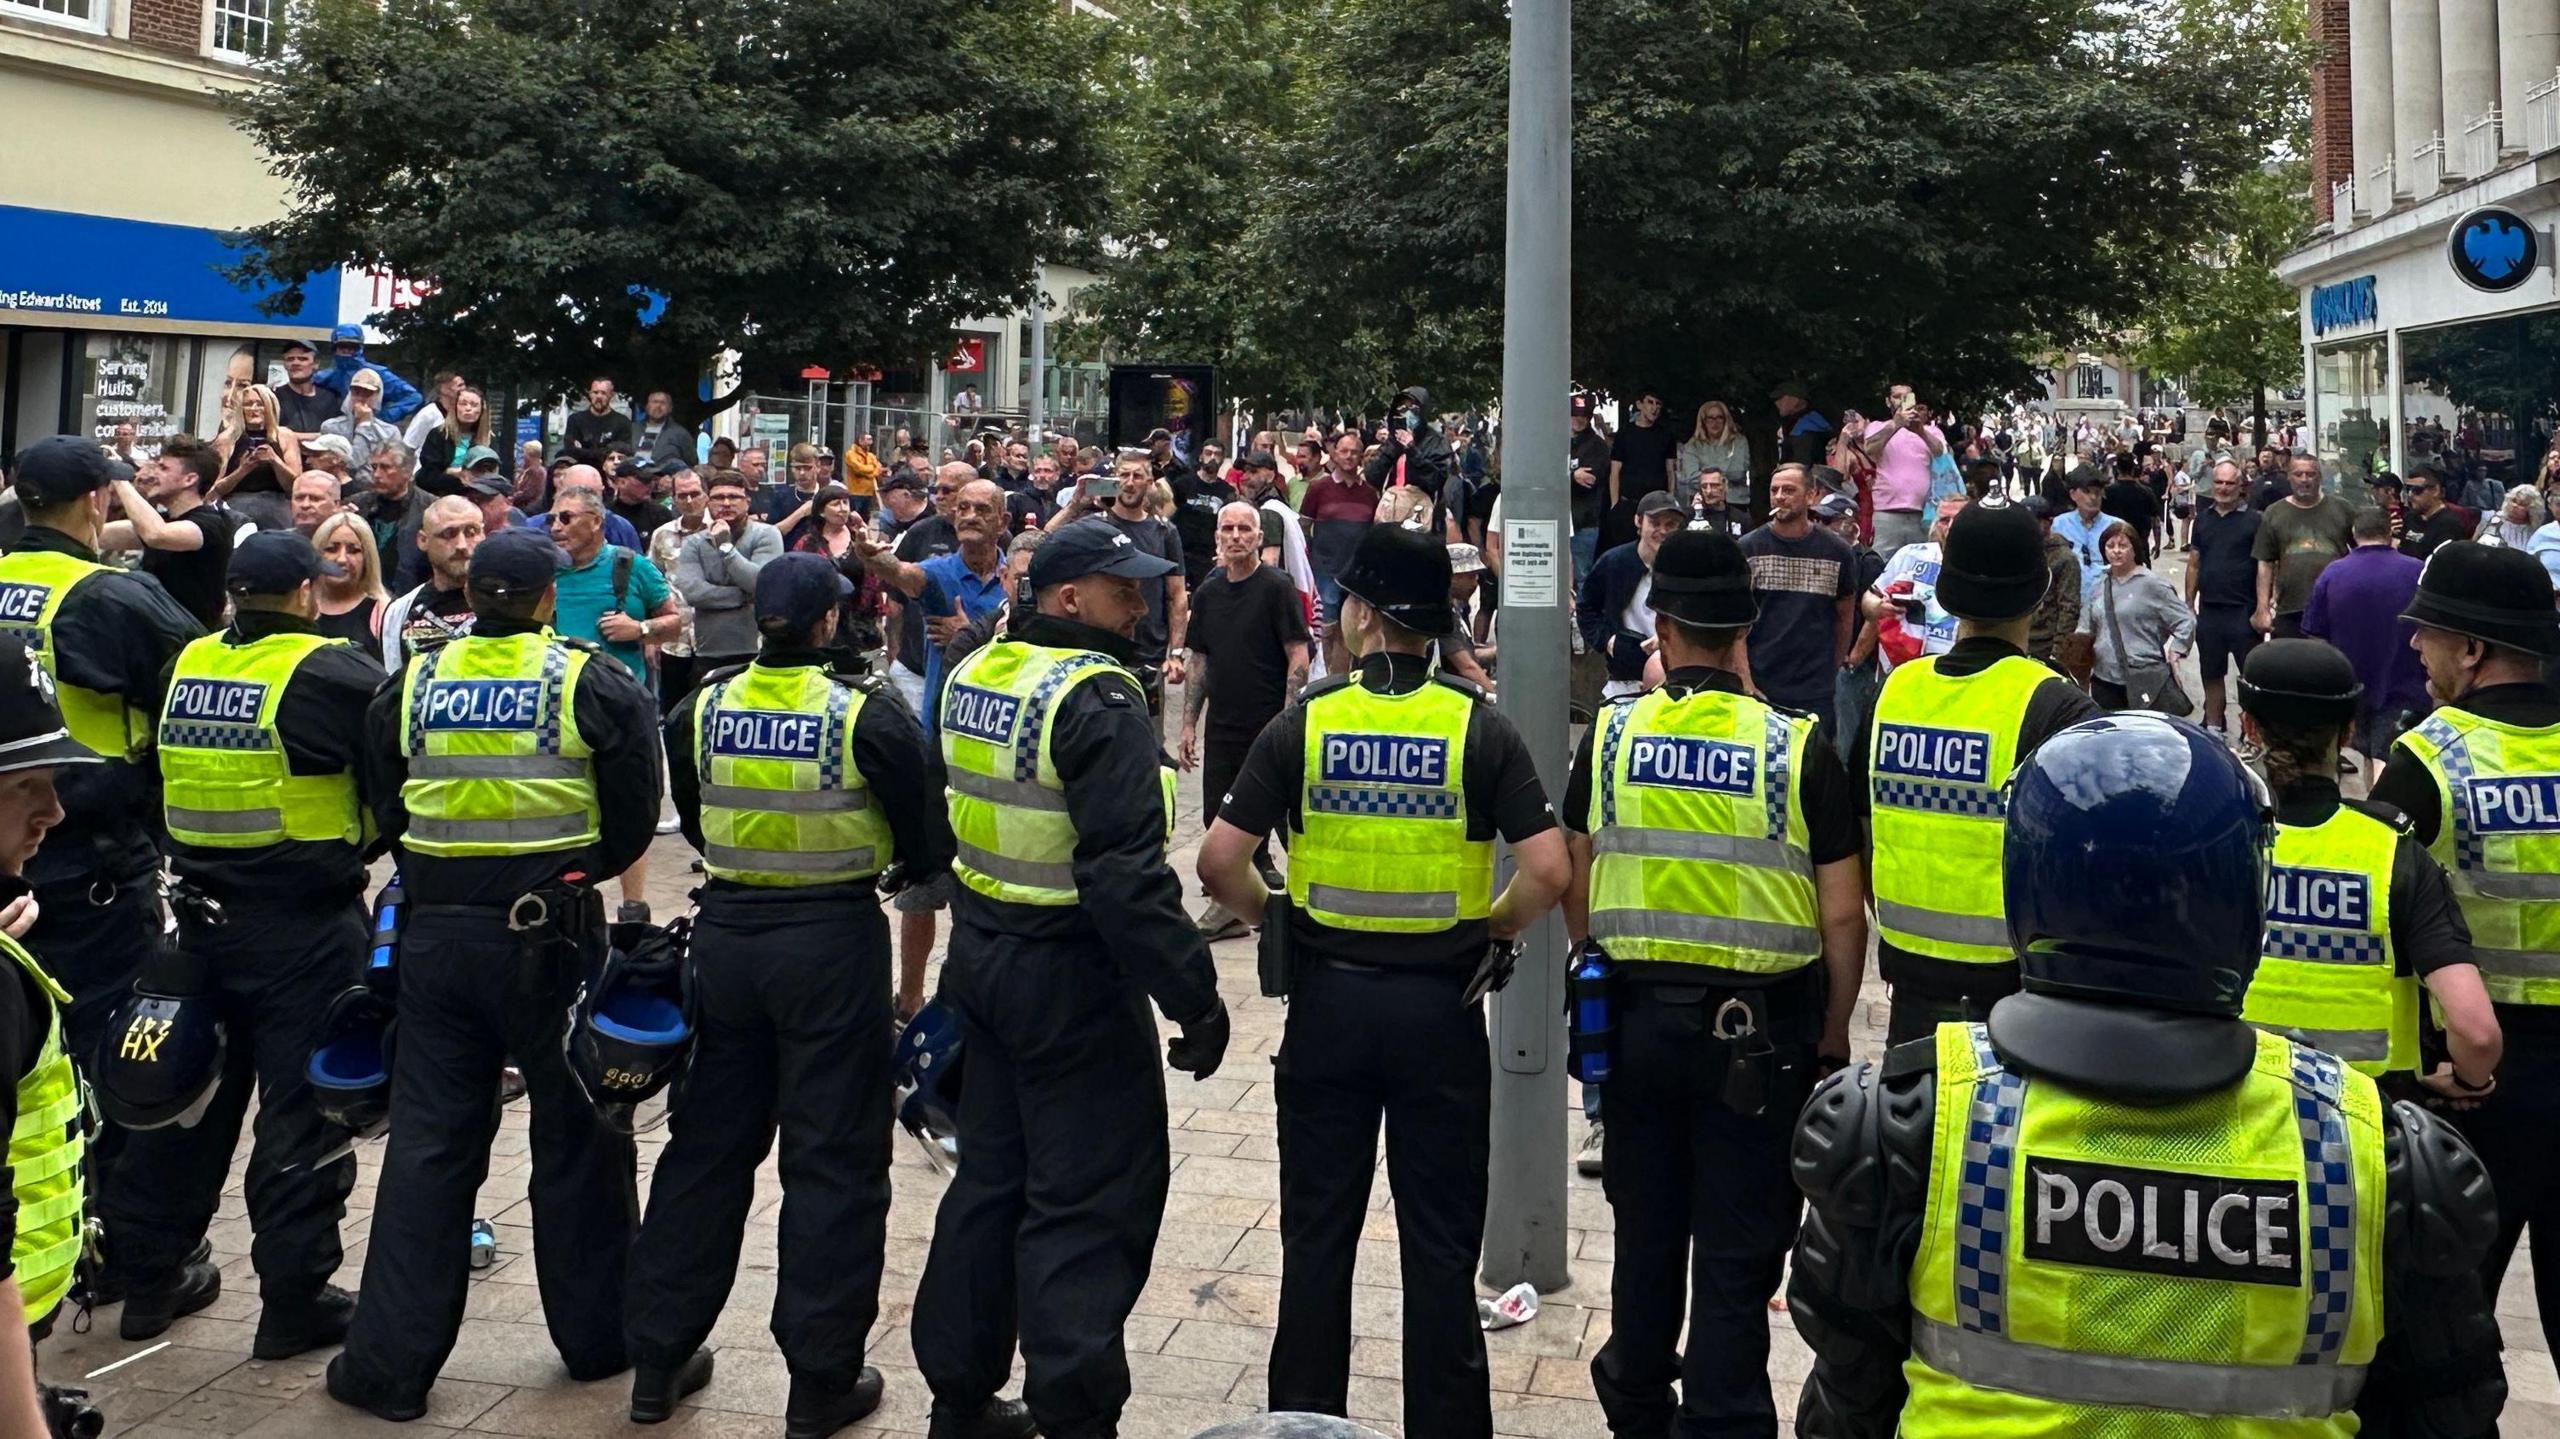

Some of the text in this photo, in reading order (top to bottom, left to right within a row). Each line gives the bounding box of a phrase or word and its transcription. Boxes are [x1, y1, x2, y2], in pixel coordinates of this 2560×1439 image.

[20, 291, 65, 309] Edward
[66, 294, 101, 312] Street
[98, 358, 148, 379] Serving
[171, 682, 261, 718] POLICE
[429, 682, 538, 723] POLICE
[946, 690, 1015, 735] POLICE
[714, 715, 818, 754] POLICE
[1879, 730, 1983, 777] POLICE
[1326, 738, 1442, 780] POLICE
[1633, 741, 1752, 787] POLICE
[128, 1015, 173, 1035] 247
[120, 1031, 169, 1062] XH
[2032, 1166, 2294, 1268] POLICE
